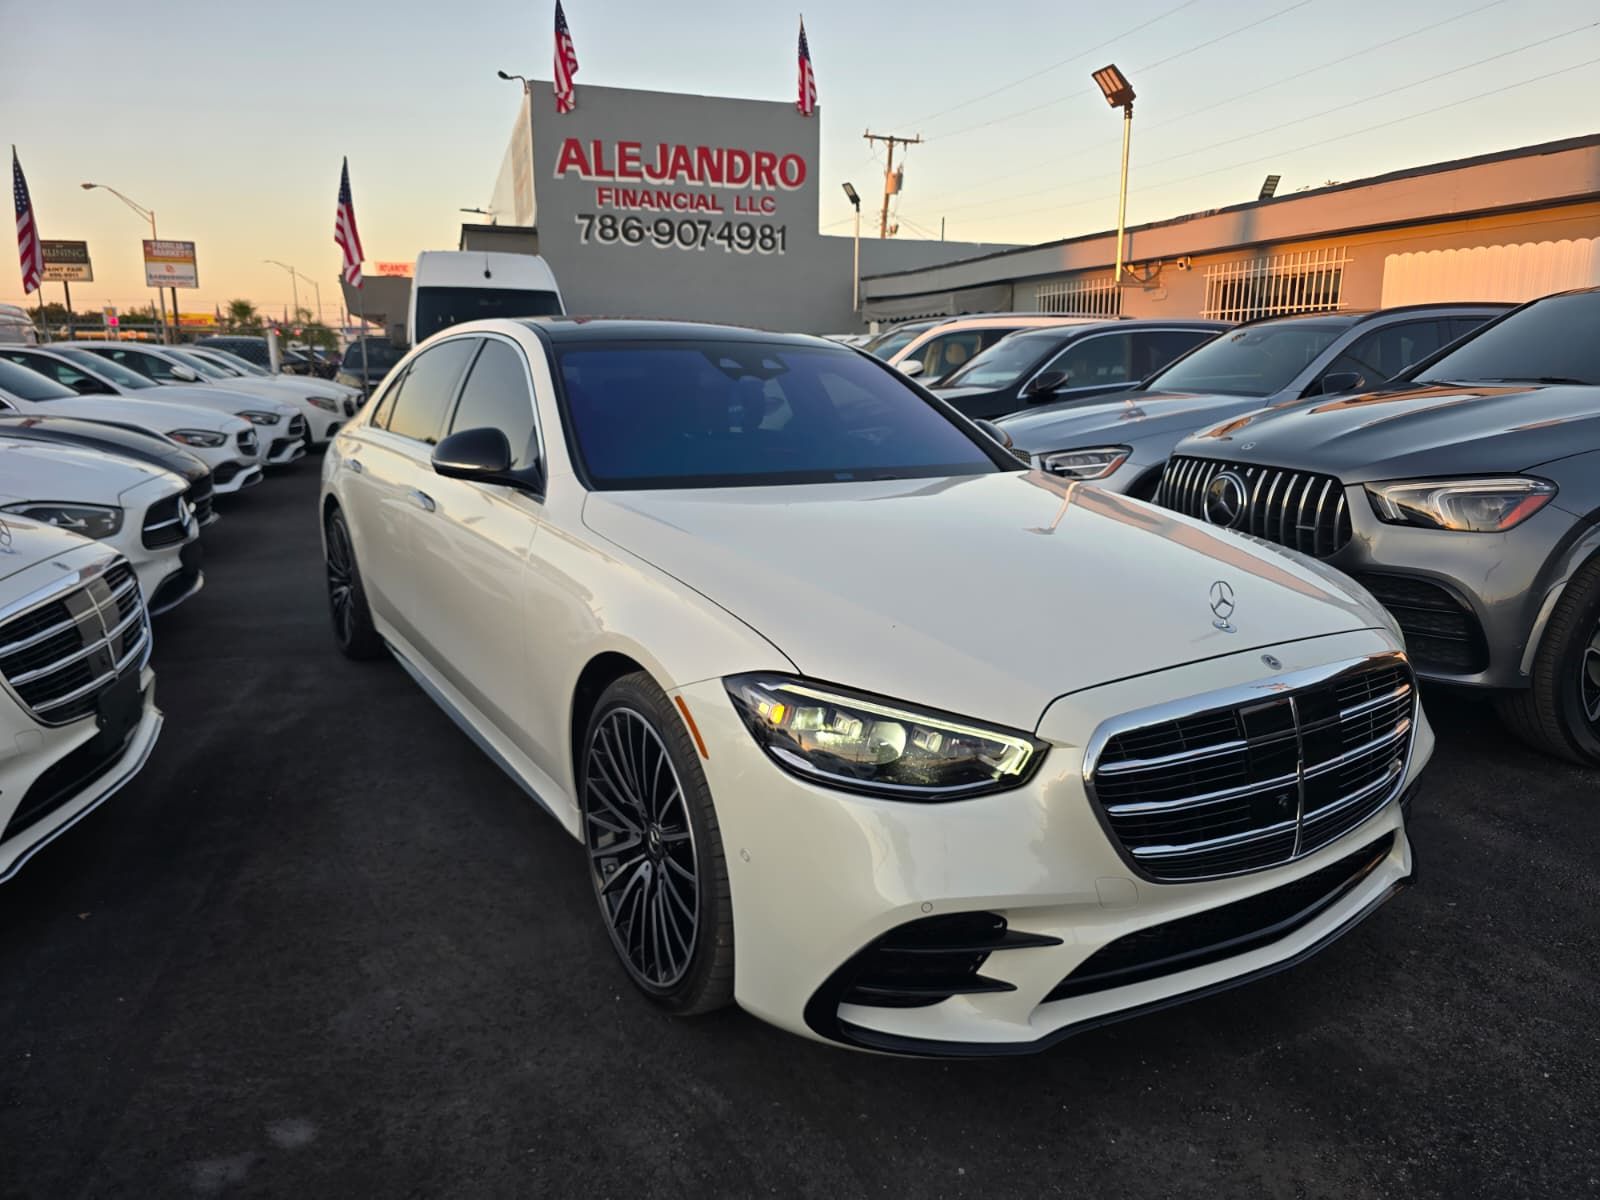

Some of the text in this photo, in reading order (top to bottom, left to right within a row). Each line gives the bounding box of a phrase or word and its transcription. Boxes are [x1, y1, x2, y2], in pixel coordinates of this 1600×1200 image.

[553, 138, 807, 191] ALEJANDRO
[596, 187, 776, 215] FINANCIAL LLC
